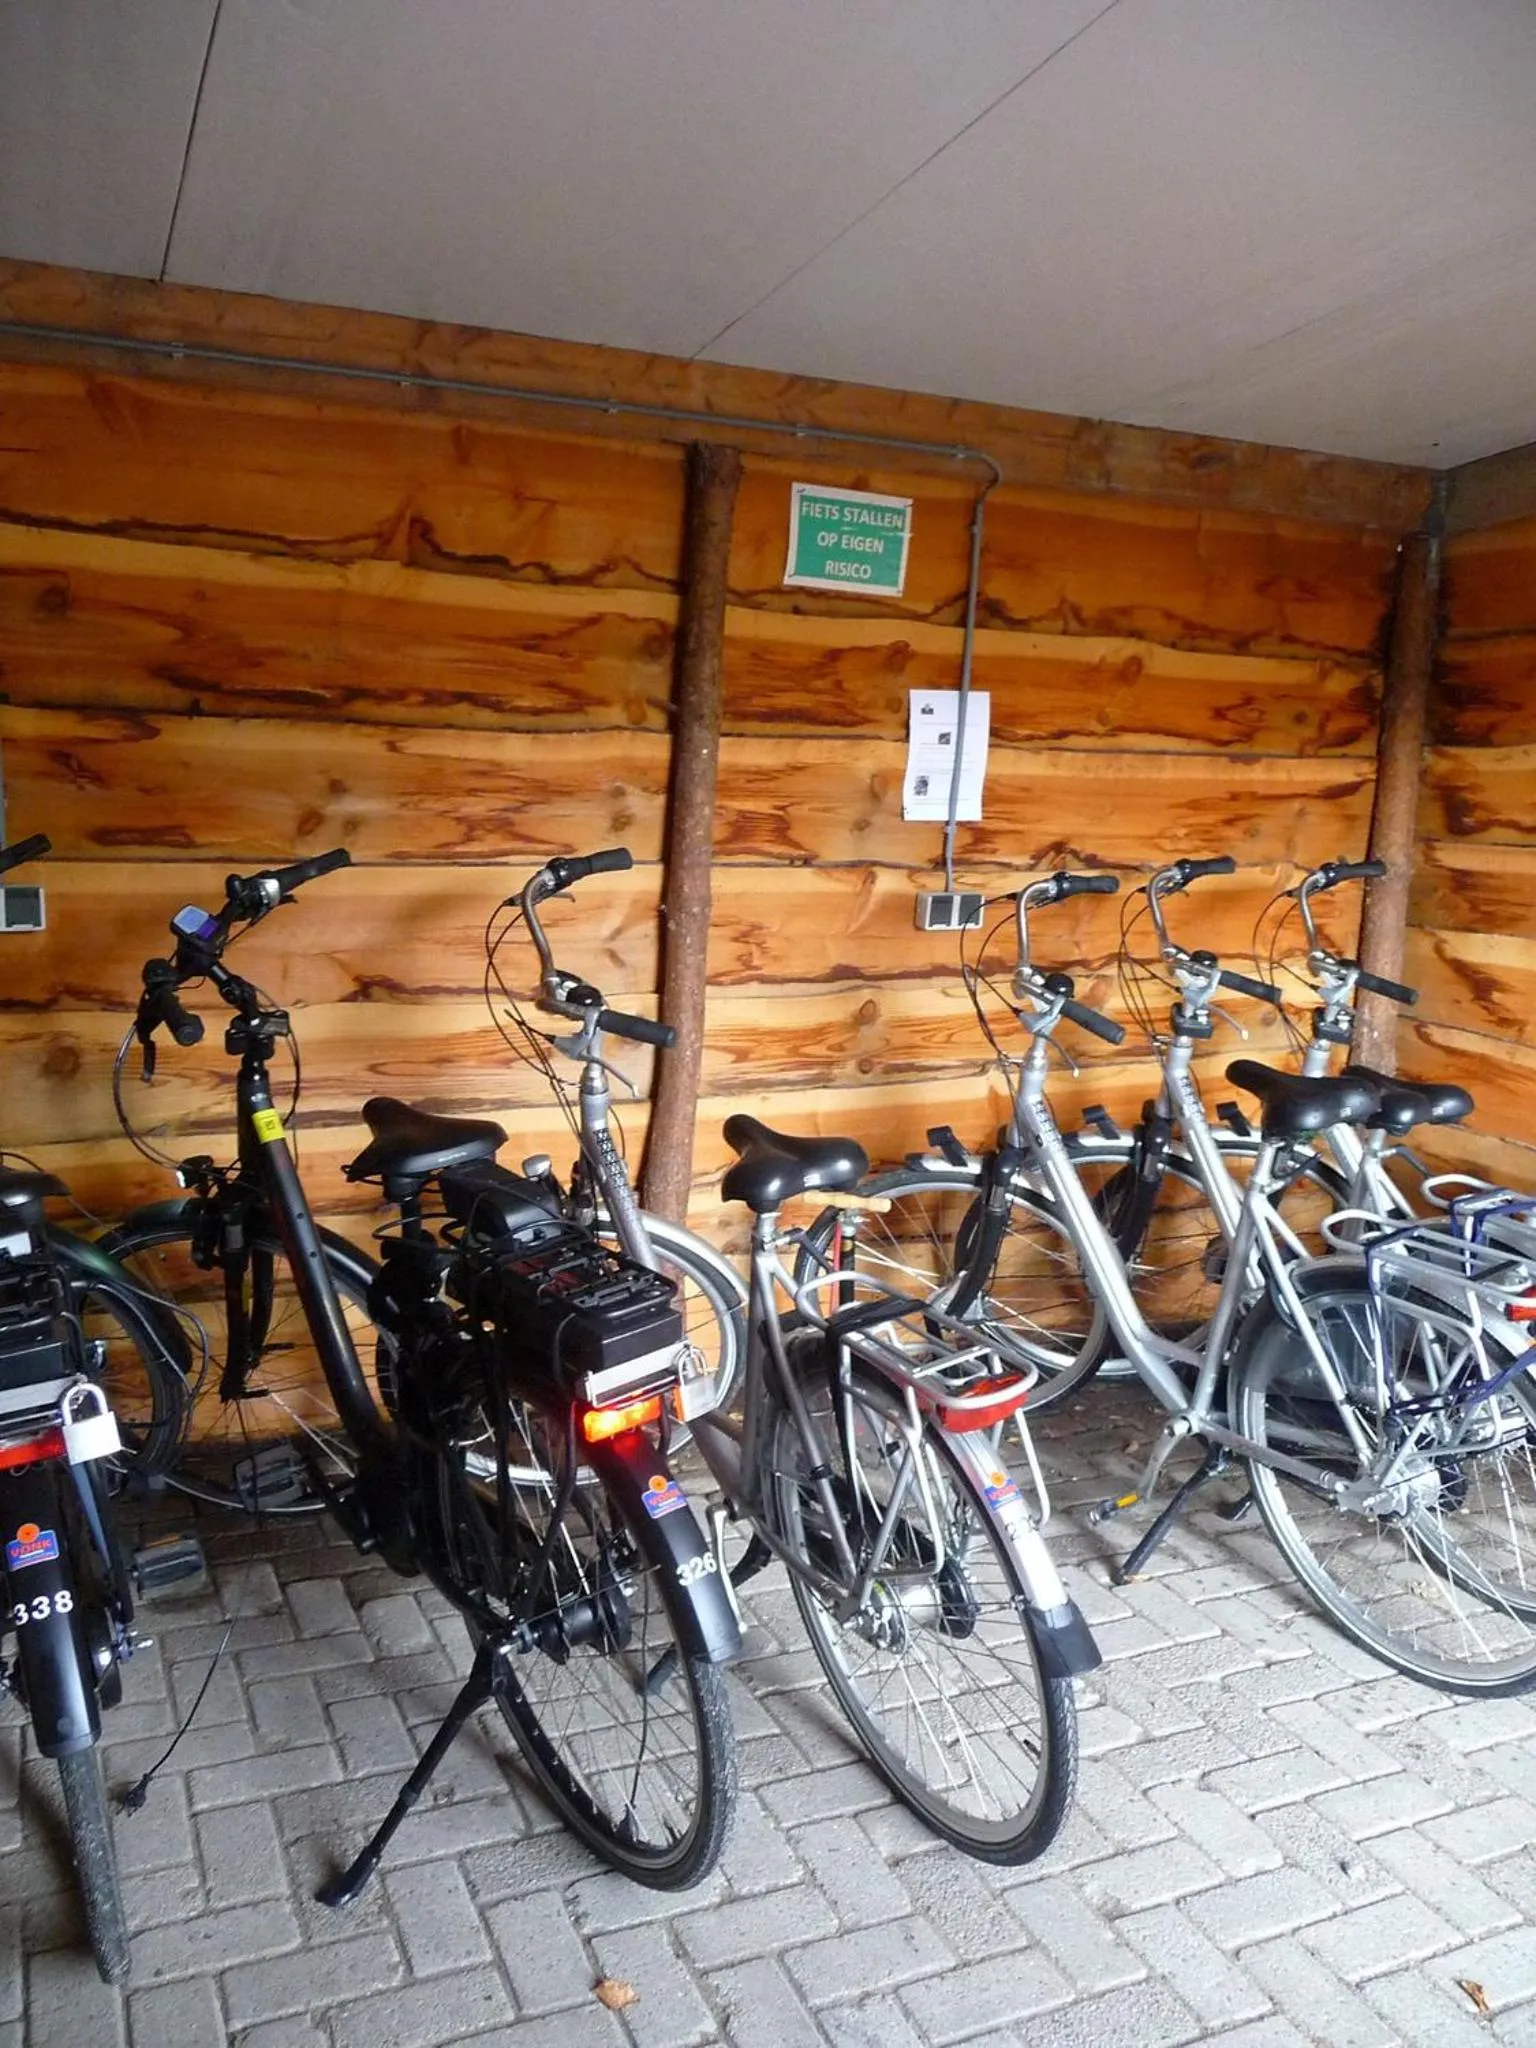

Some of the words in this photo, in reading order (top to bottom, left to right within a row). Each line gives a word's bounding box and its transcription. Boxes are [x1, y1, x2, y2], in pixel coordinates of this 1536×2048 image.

[801, 501, 839, 520] FIETS
[843, 507, 904, 529] STALLEN
[817, 531, 838, 547] OP
[842, 535, 884, 553] EIGEN
[825, 560, 872, 579] RISICO
[676, 1552, 717, 1586] 326
[13, 1590, 73, 1625] 338
